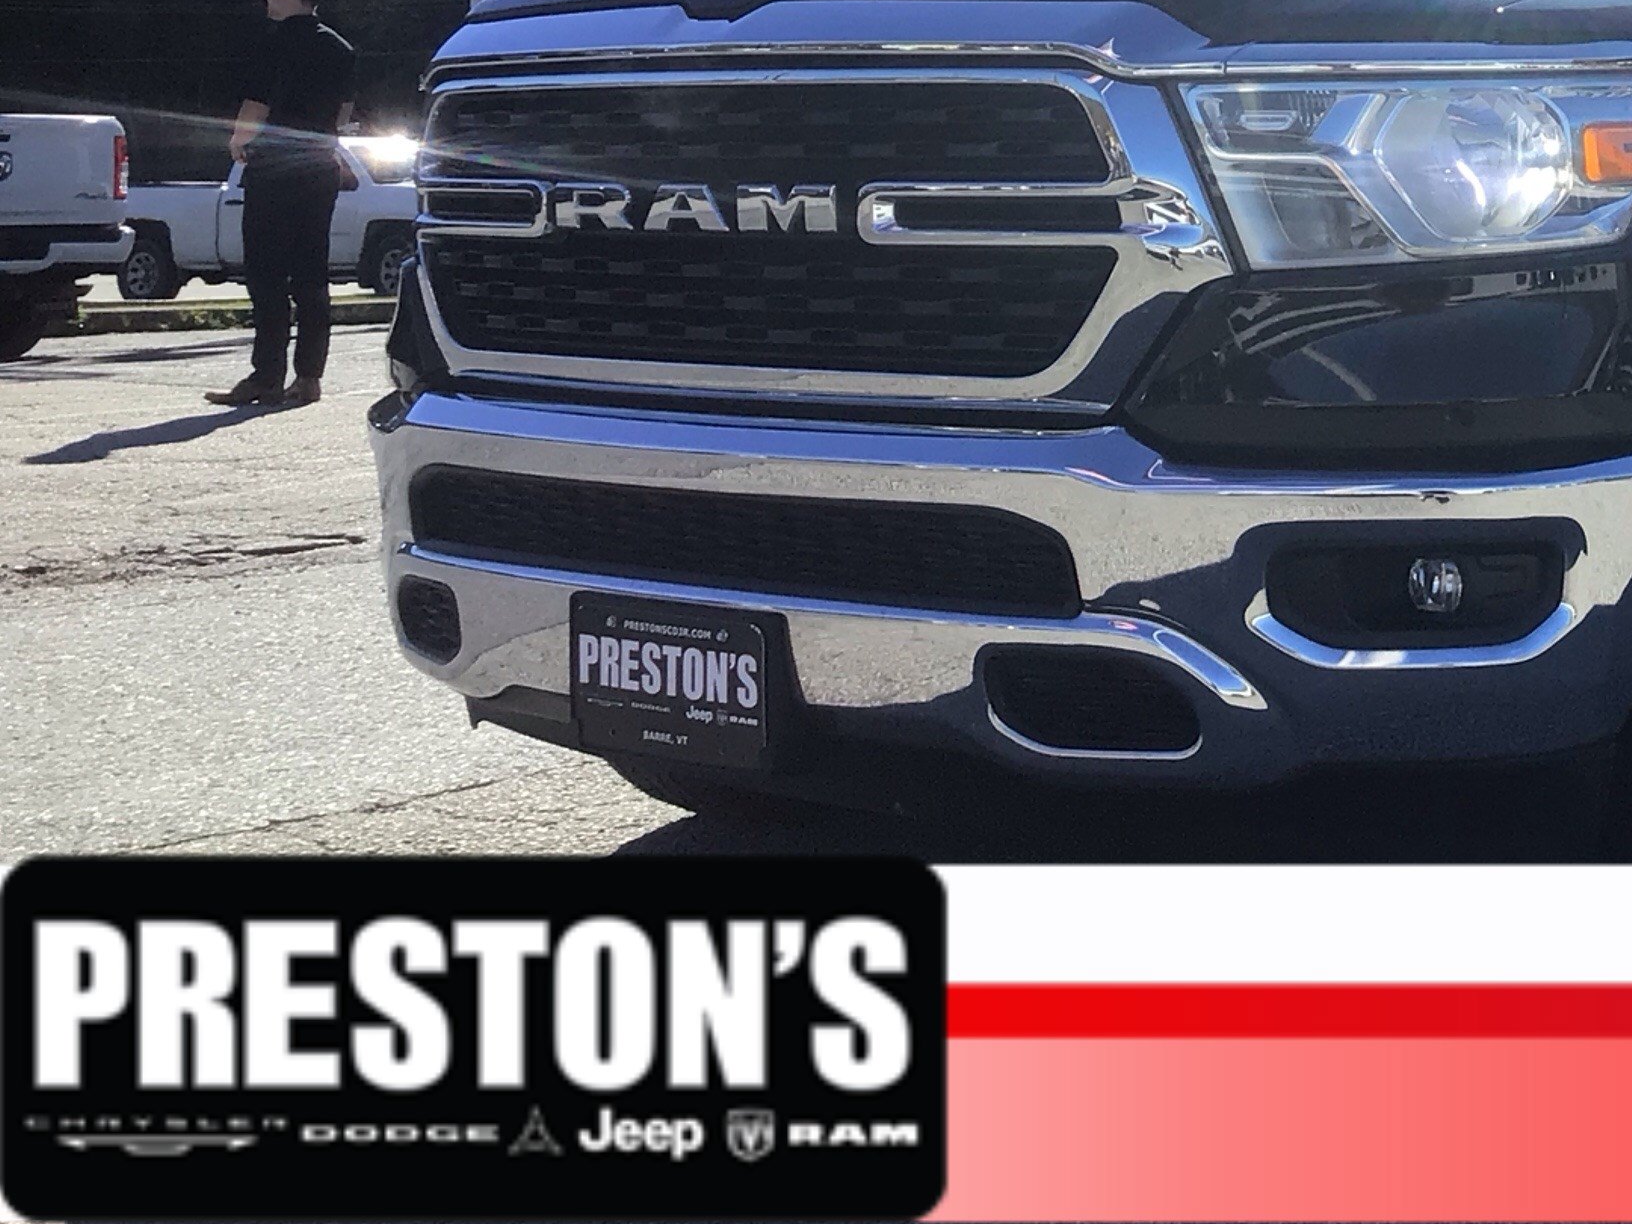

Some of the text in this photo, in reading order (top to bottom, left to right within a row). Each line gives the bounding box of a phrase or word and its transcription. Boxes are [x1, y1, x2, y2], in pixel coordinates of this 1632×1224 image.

[552, 184, 838, 232] RAM
[578, 633, 758, 709] PRESTON'S
[685, 705, 714, 724] Jeep
